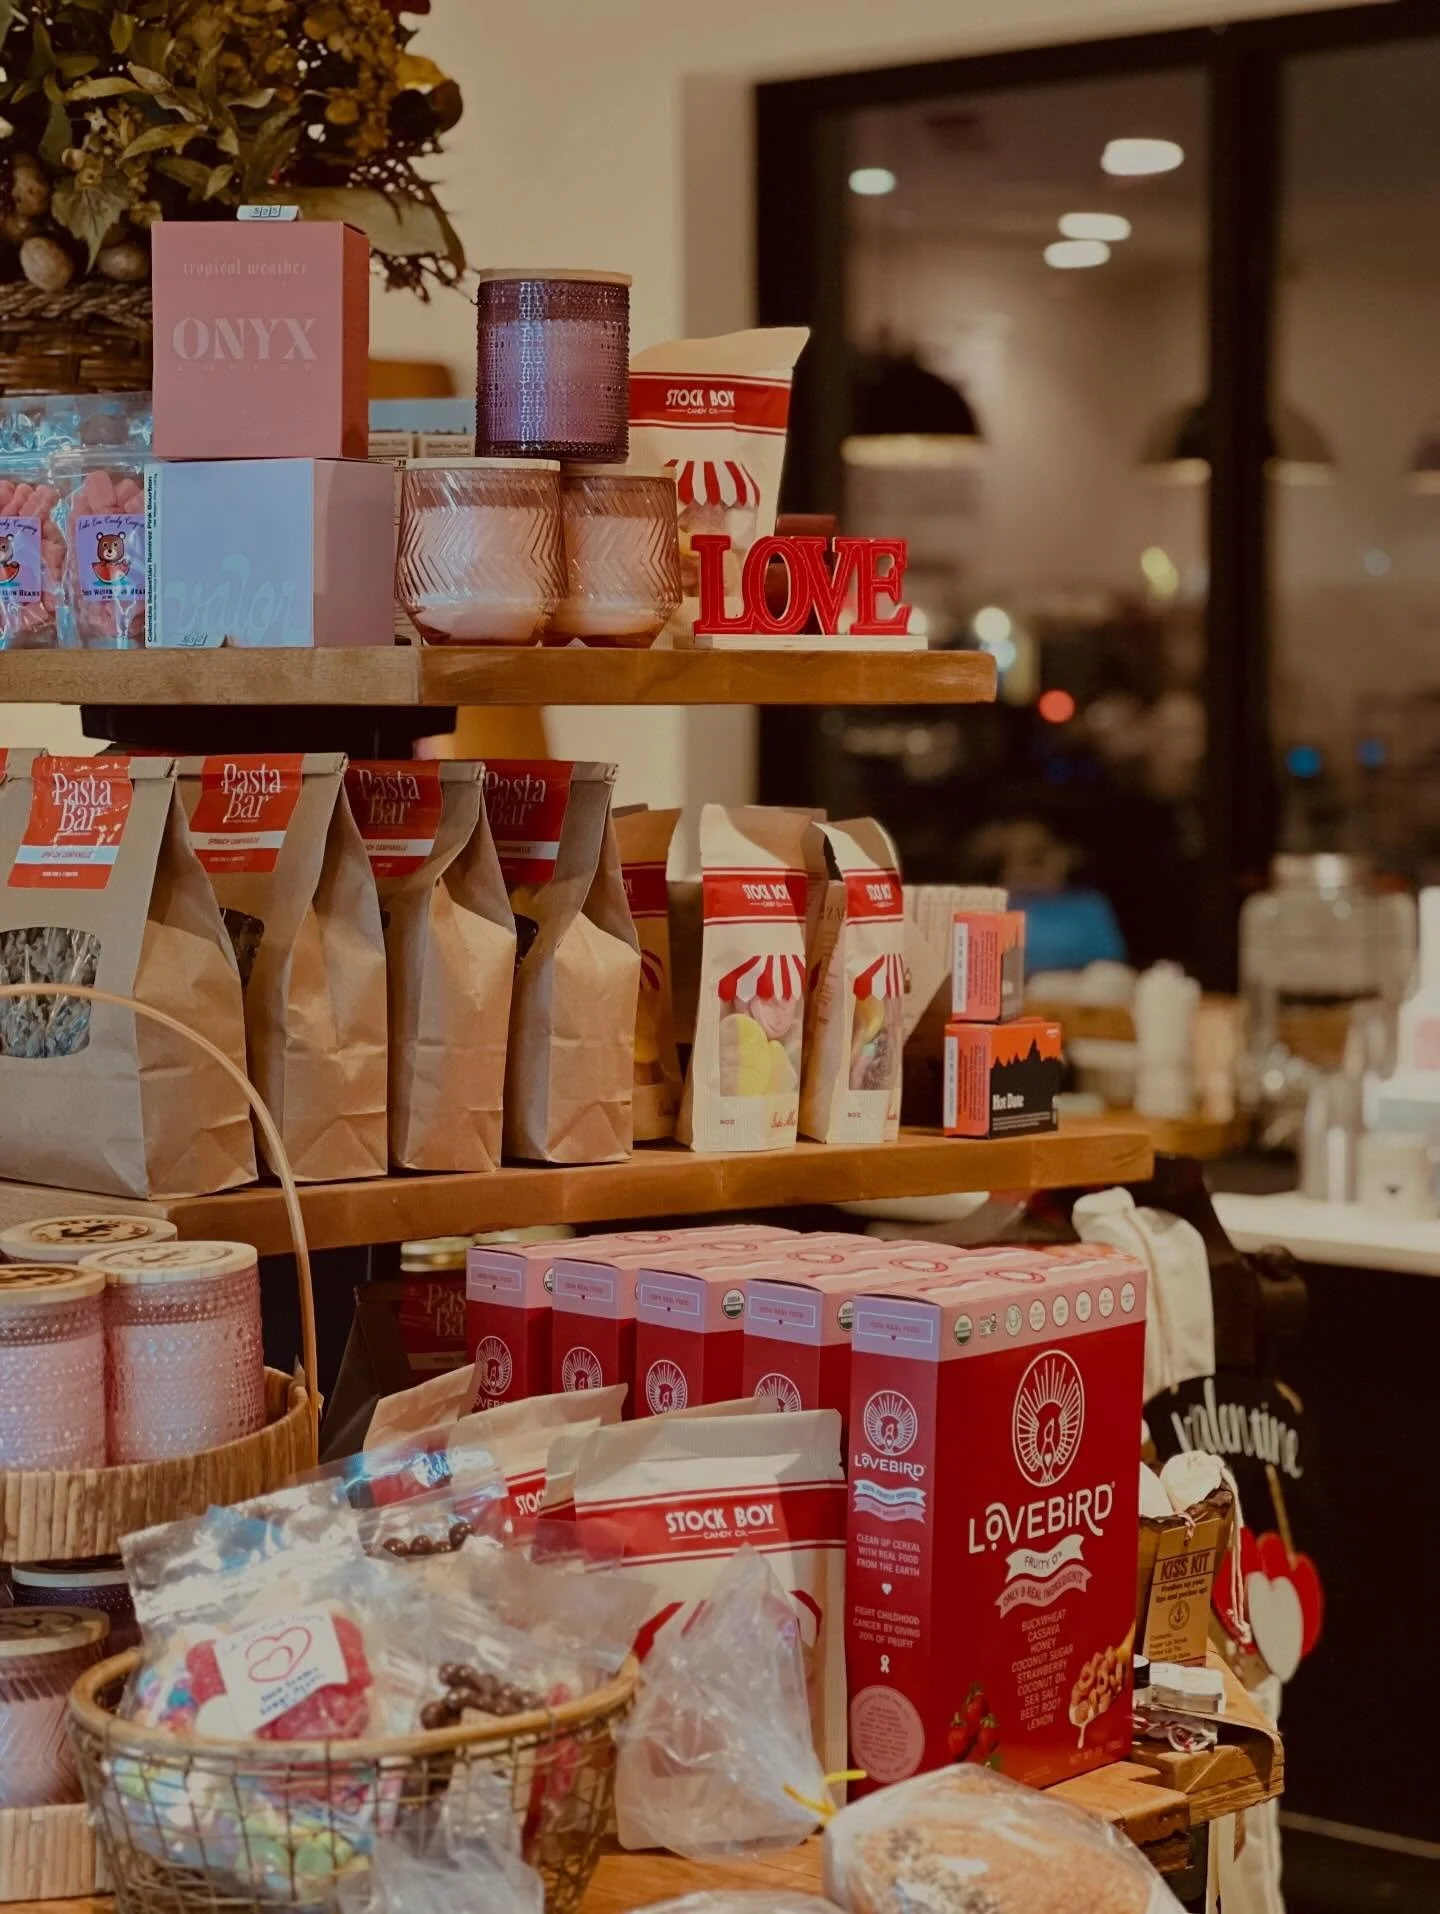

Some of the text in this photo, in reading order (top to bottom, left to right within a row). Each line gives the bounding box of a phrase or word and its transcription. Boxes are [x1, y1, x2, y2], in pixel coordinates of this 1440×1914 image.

[183, 255, 310, 279] tropical weather
[172, 316, 320, 361] ONYX
[665, 389, 736, 407] STOCK BOY
[691, 534, 912, 637] LOVE
[52, 773, 112, 806] Pasta
[221, 763, 281, 794] Pasta
[357, 770, 421, 800] Pasta
[485, 771, 546, 803] Pasta
[57, 799, 104, 831] Bar
[226, 788, 270, 820] Bar
[368, 795, 411, 825] Bar
[489, 798, 532, 825] Bar
[425, 1284, 467, 1315] Pas
[436, 1308, 466, 1337] Ba
[514, 1488, 545, 1517] STOC
[665, 1504, 775, 1534] STOCK BOY
[703, 1530, 733, 1540] CANDY
[856, 1534, 921, 1553] CLEAN UP CEREAL
[856, 1558, 920, 1577] FROM THE EARTH
[858, 1546, 919, 1564] WITH REAL FOOD
[1024, 1555, 1050, 1569] FRUITY
[1160, 1551, 1211, 1581] KISS KIT
[854, 1605, 920, 1625] FIGHT CHILDHOOD
[1021, 1609, 1067, 1632] BUCKWHEAT
[853, 1618, 881, 1631] CANCER
[894, 1625, 921, 1638] GIVING
[1027, 1623, 1061, 1643] CASSAVA
[1011, 1643, 1074, 1673] COCONUT SUGAR
[1030, 1637, 1056, 1654] HONEY
[1017, 1659, 1067, 1684] STRAWBERRY
[1017, 1672, 1067, 1697] COCONUT OIL
[1024, 1686, 1059, 1707] SEA SALT
[1020, 1705, 1040, 1721] BEET
[1026, 1714, 1054, 1731] LEMON
